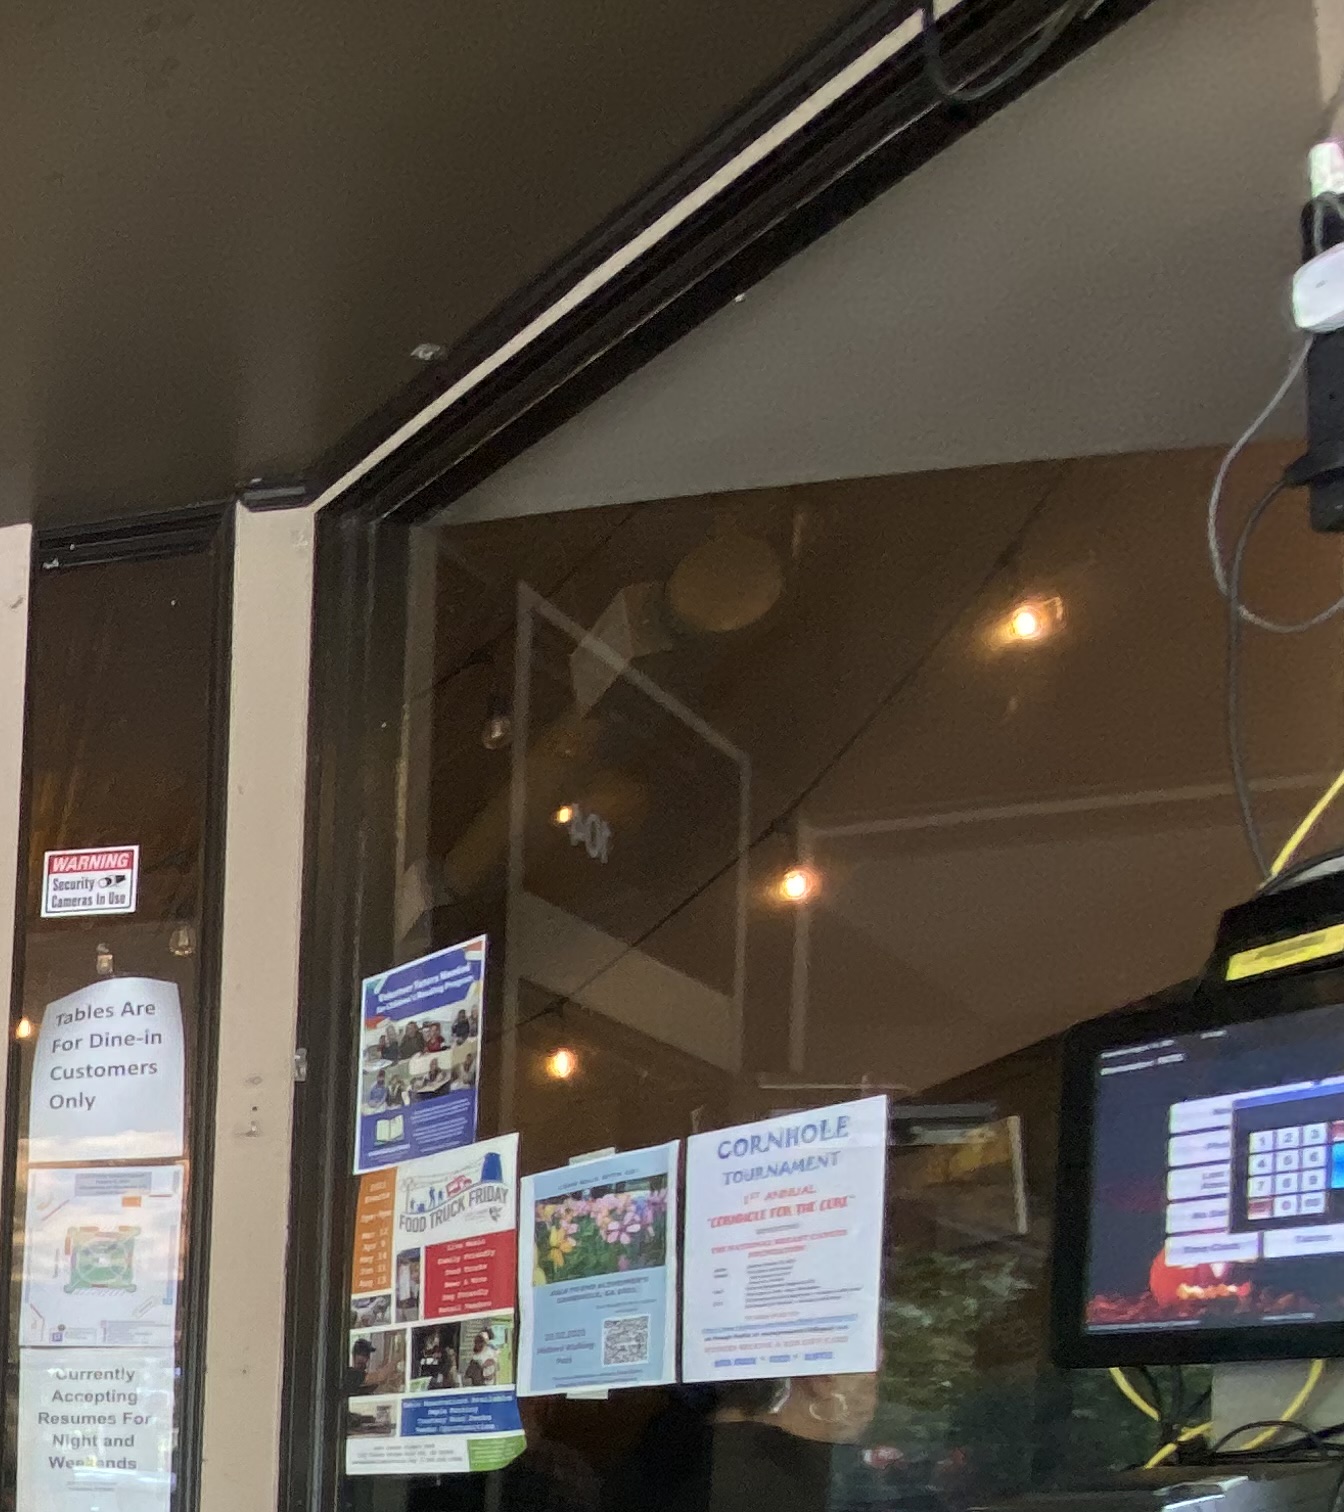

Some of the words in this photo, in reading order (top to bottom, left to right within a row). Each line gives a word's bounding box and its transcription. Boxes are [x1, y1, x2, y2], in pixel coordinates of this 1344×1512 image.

[52, 853, 130, 872] WARNING
[53, 876, 95, 891] Security
[51, 894, 93, 908] Cameras
[108, 891, 126, 904] Use
[56, 1004, 114, 1027] Tables
[120, 1001, 156, 1017] Are
[52, 1037, 83, 1053] For
[90, 1029, 162, 1048] Dine-in
[50, 1062, 158, 1081] Customers
[49, 1092, 96, 1110] Only
[717, 1115, 850, 1159] CORNHOLE
[723, 1150, 841, 1185] TOURNAMENT
[399, 1213, 427, 1233] FOOD
[429, 1195, 465, 1229] TRUCK
[468, 1185, 509, 1207] FRIDAY
[56, 1367, 136, 1383] Currently
[52, 1389, 138, 1405] Accepting
[38, 1411, 117, 1425] Resumes
[122, 1411, 152, 1425] For
[52, 1434, 98, 1450] Night
[104, 1434, 135, 1447] and
